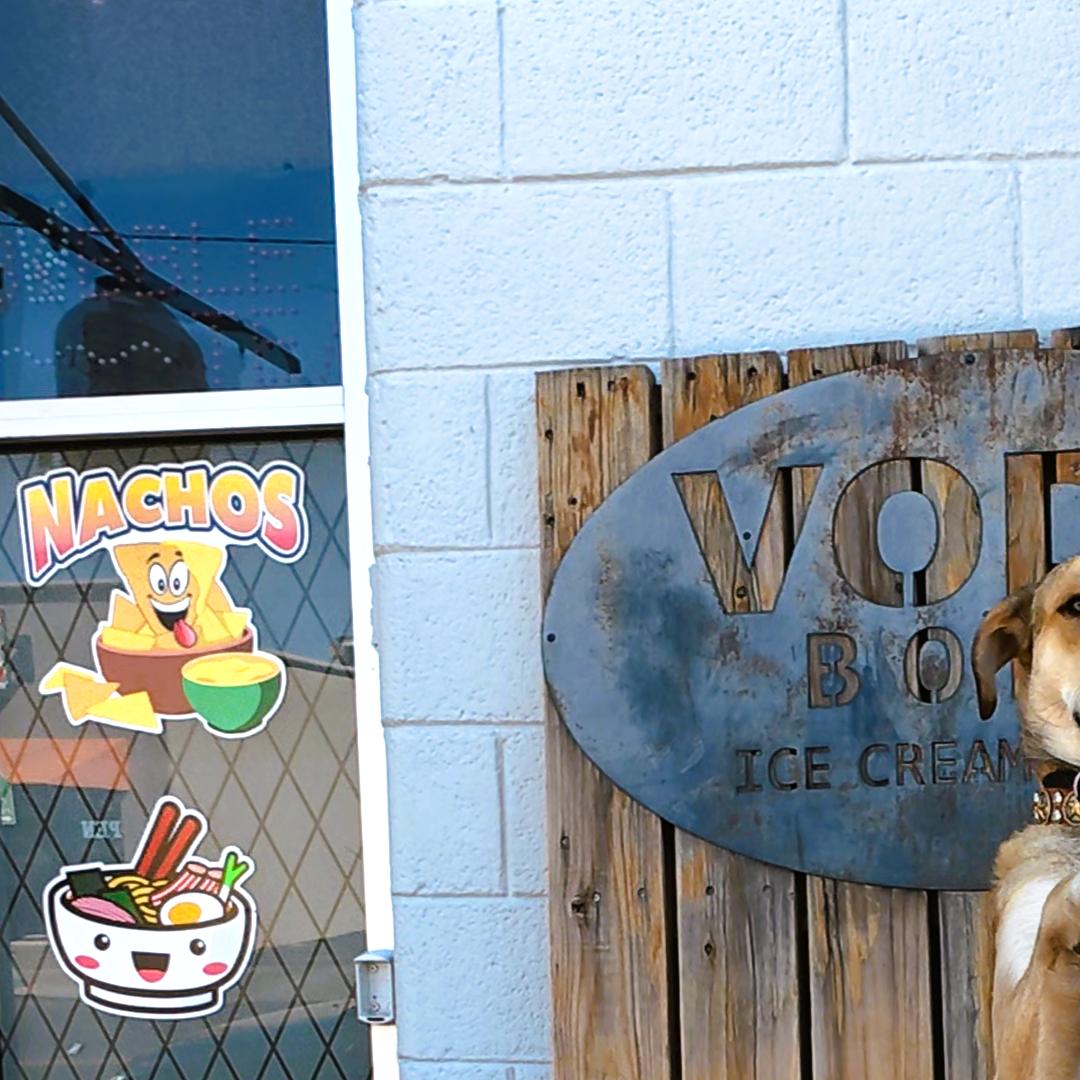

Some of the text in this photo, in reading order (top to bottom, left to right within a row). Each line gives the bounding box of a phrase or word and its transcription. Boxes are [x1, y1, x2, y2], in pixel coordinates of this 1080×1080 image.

[20, 462, 306, 584] NACHOS
[734, 737, 1036, 795] ICE CREAM
